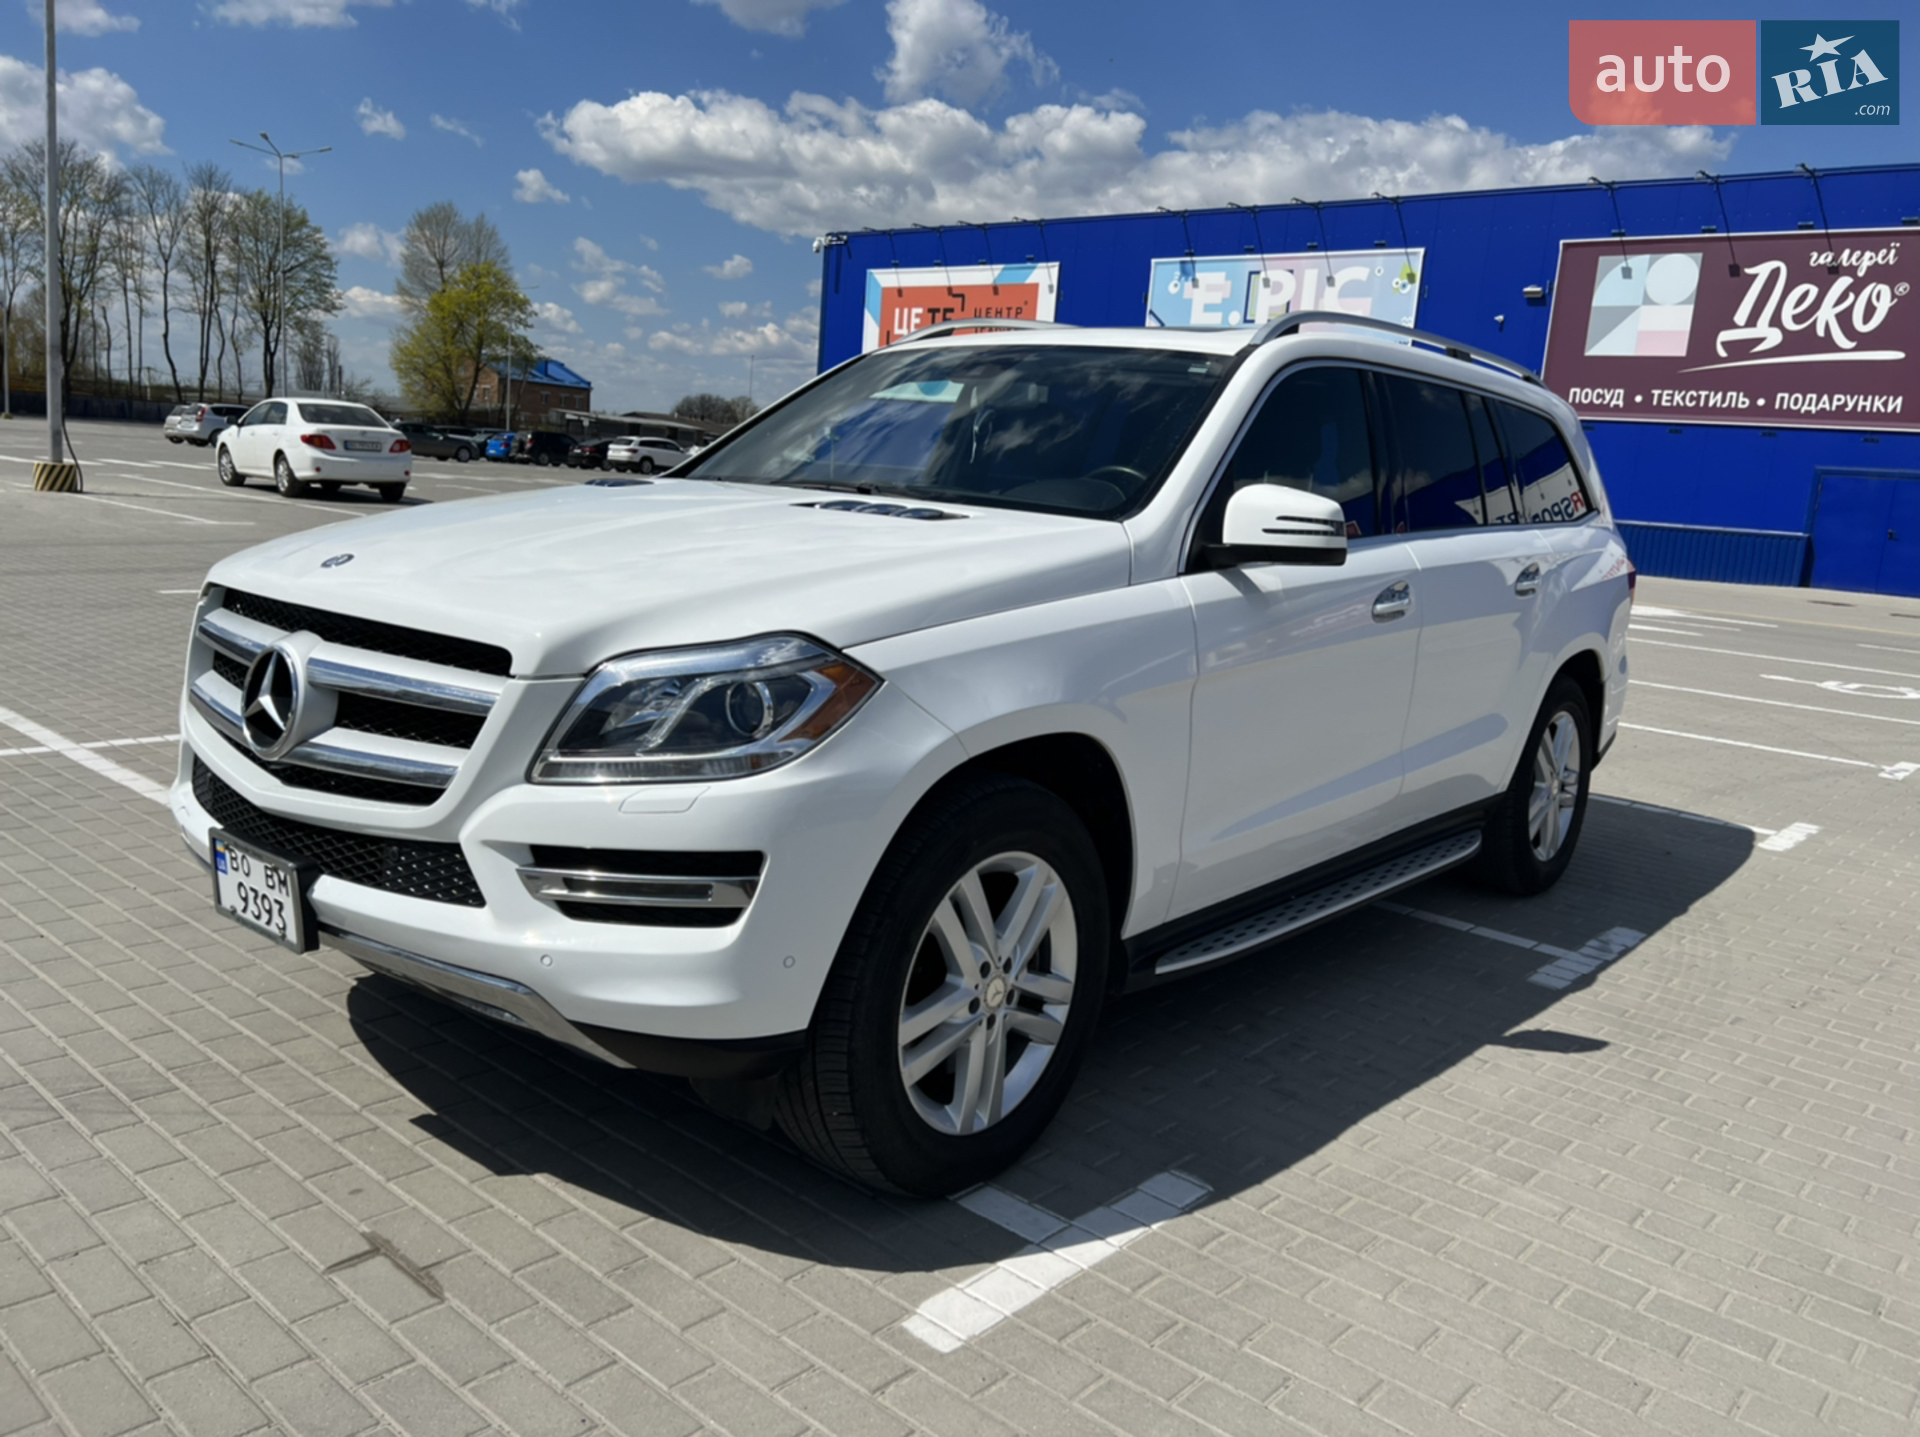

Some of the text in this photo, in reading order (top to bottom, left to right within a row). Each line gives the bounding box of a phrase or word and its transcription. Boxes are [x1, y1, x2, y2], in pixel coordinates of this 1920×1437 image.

[1809, 241, 1901, 278] галереї
[1568, 387, 1904, 414] ПОСУД ТЕКСТИЛЬ ПОДАРУНКИ
[237, 881, 287, 935] 9393
